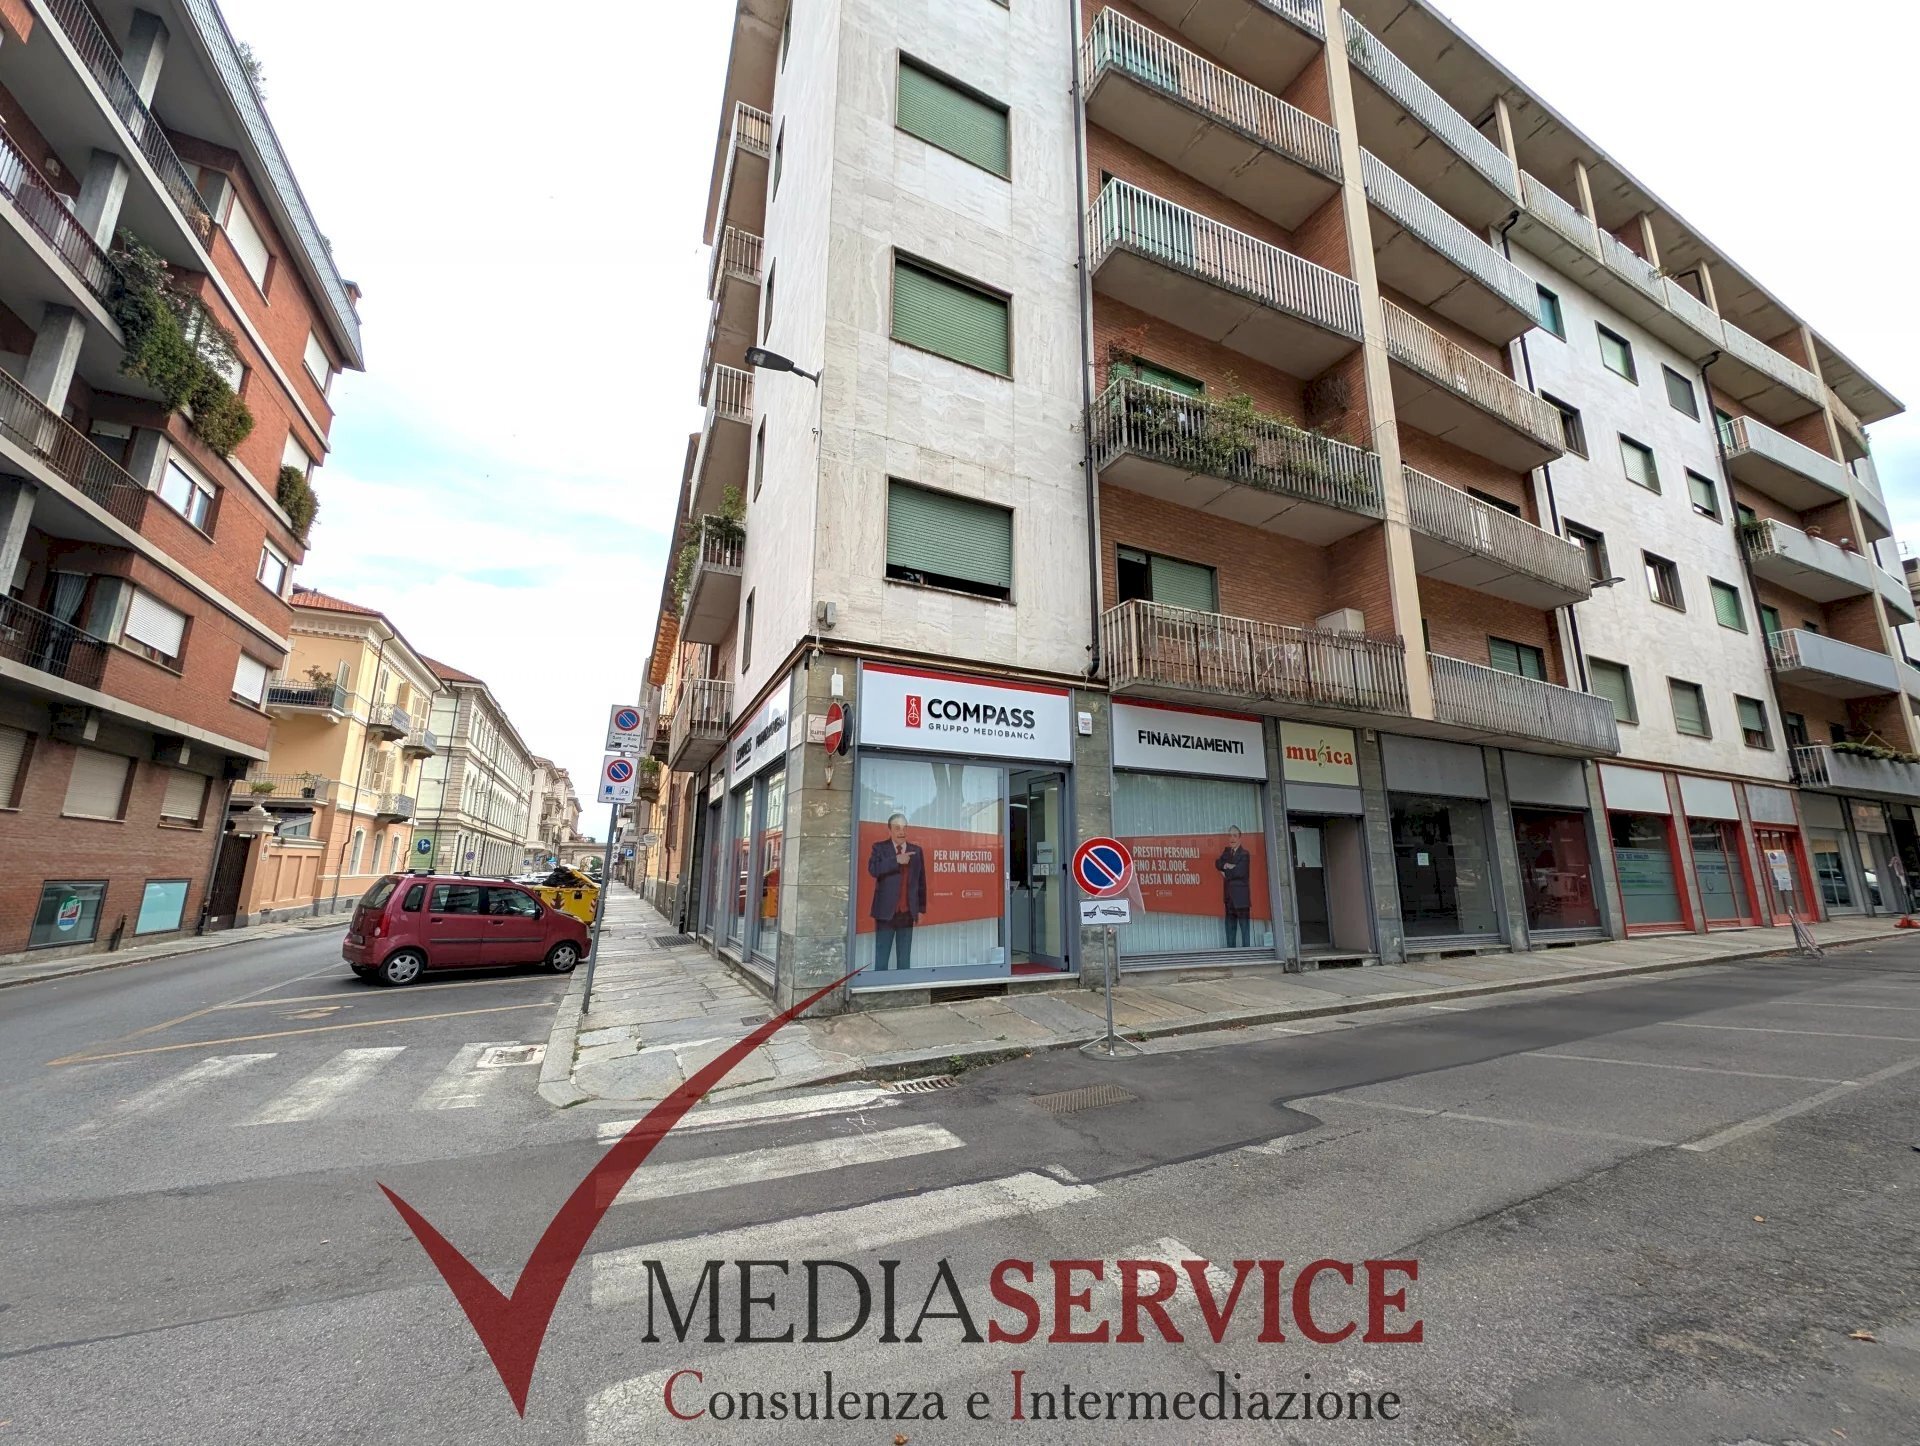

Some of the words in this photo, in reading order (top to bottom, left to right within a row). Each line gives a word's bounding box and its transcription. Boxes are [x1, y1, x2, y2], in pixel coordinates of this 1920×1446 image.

[928, 699, 1036, 729] COMPASS
[929, 722, 969, 734] GRUPPO
[974, 727, 1035, 740] MEDIOBANCA
[1138, 729, 1244, 755] FINANZIAMENTI
[934, 850, 948, 860] PER
[950, 850, 960, 860] UN
[961, 851, 992, 861] PRESTITO
[1133, 846, 1162, 858] PRESTITI
[1164, 847, 1200, 858] PERSONALI
[934, 862, 956, 873] BASTA
[957, 863, 967, 873] UN
[969, 863, 995, 873] GIORNO
[1134, 860, 1150, 871] FINO
[1152, 860, 1157, 871] A
[1140, 873, 1161, 884] BASTA
[1163, 873, 1173, 884] UN
[1175, 874, 1200, 885] GIORNO
